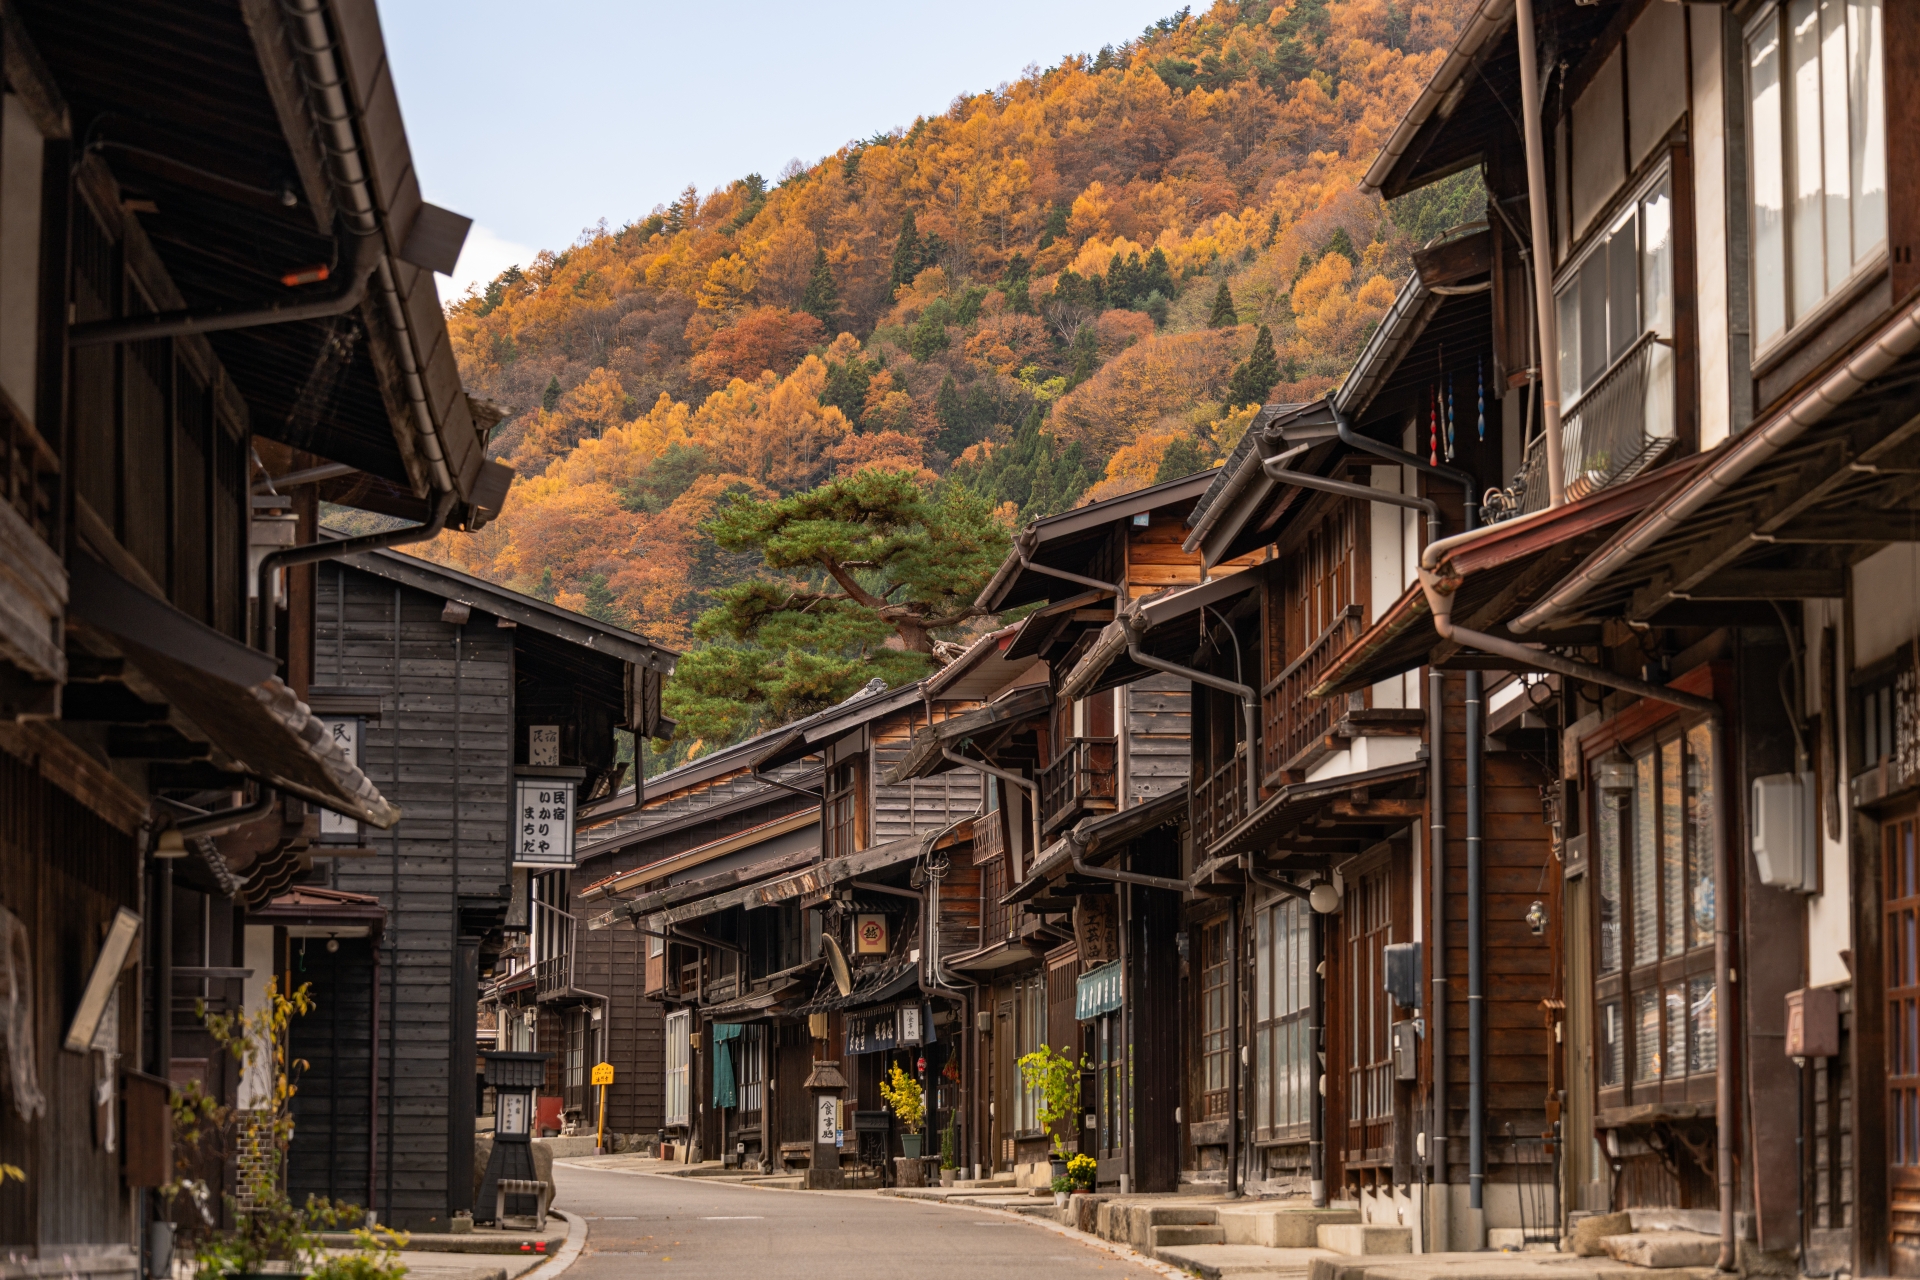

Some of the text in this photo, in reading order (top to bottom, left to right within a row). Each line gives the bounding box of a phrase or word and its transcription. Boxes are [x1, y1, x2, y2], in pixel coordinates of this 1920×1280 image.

[538, 791, 550, 853] いかりや
[553, 791, 565, 820] 民宿
[524, 806, 535, 852] まちだ
